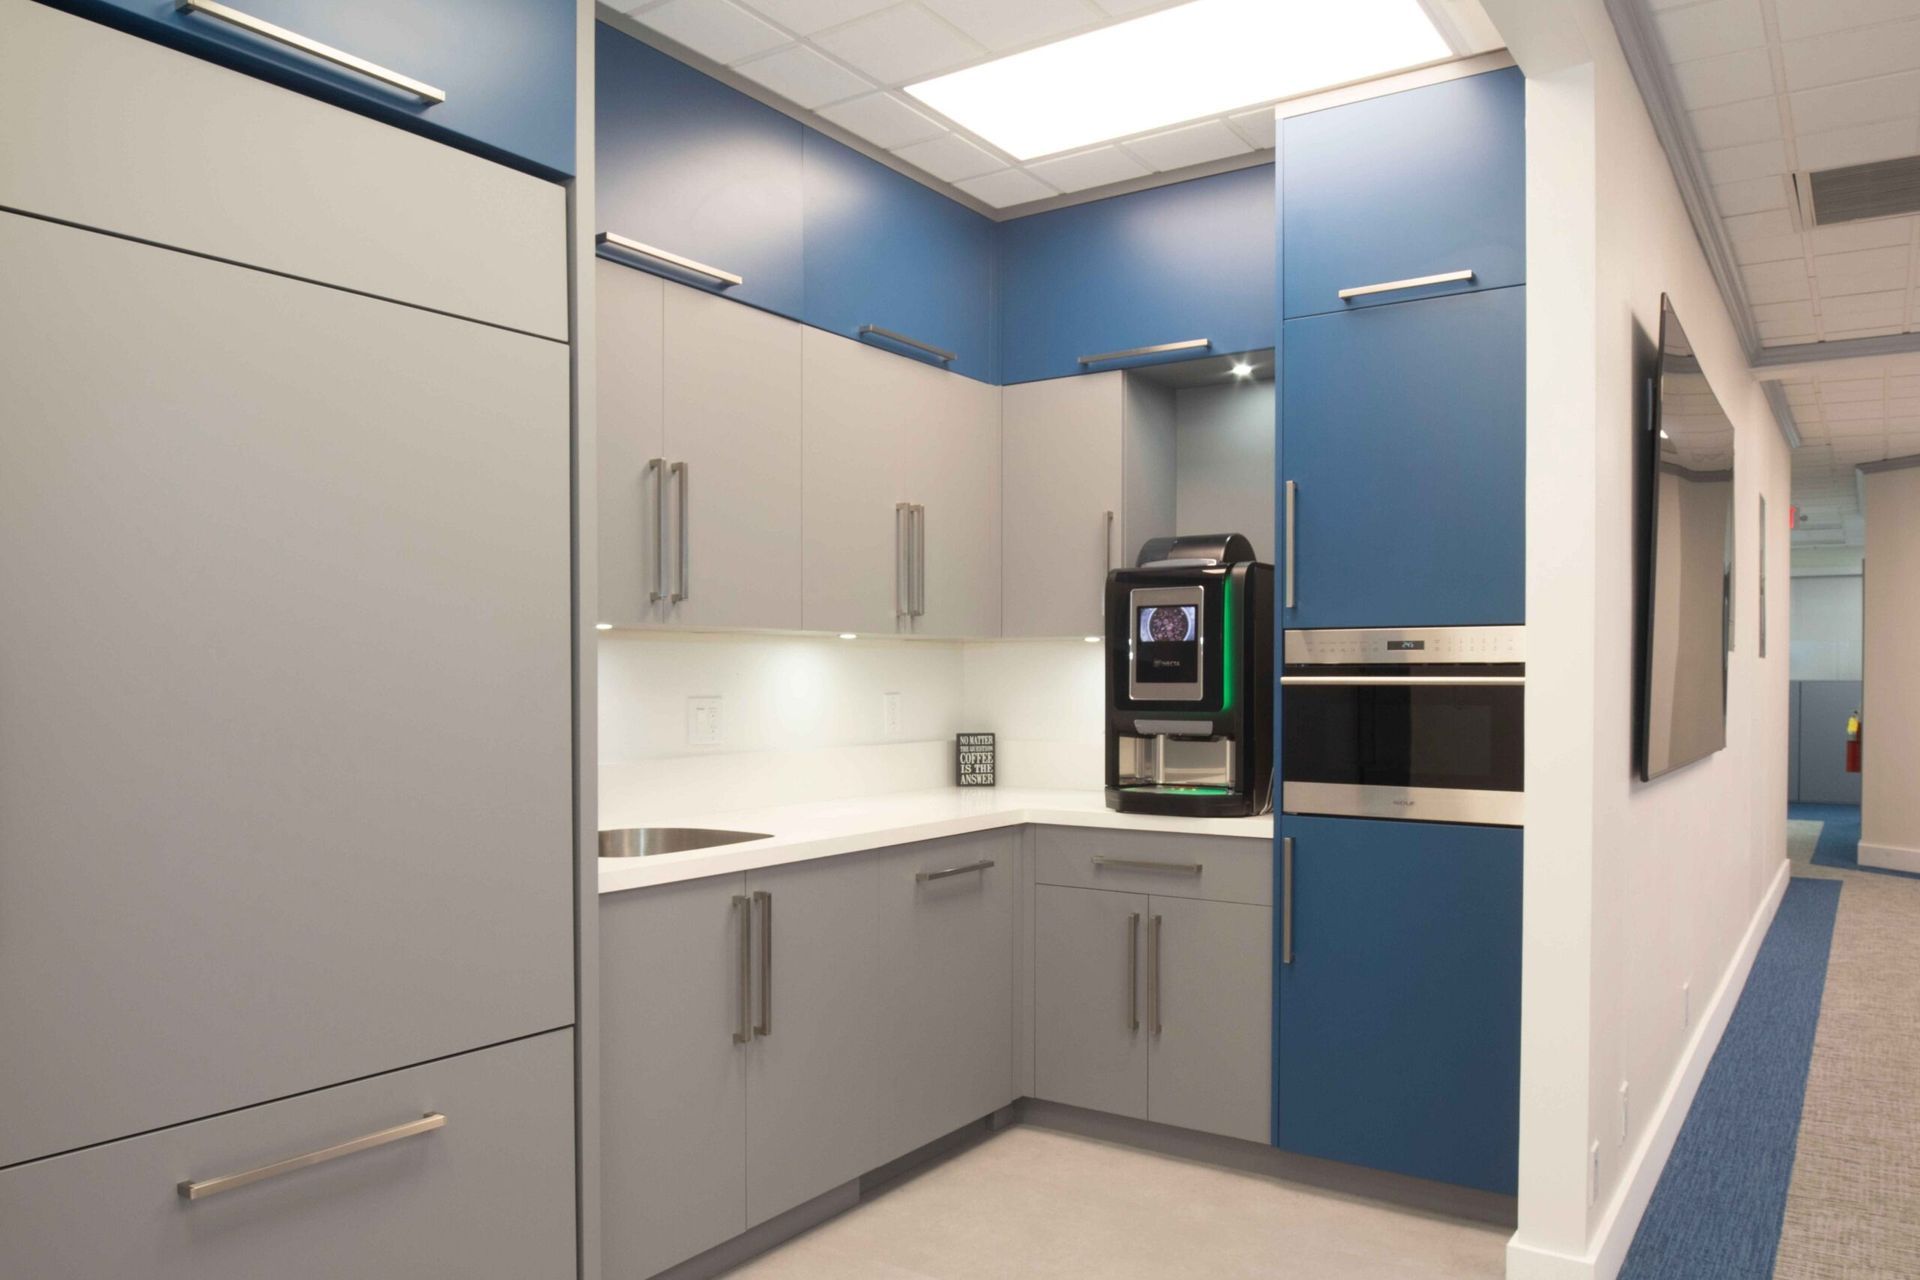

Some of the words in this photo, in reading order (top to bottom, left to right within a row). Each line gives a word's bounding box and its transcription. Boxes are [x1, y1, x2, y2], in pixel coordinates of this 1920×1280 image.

[960, 735, 969, 745] NO
[970, 735, 993, 745] MATTER
[960, 752, 993, 764] COFFEE
[960, 764, 972, 774] IS
[973, 763, 993, 773] THE
[960, 773, 993, 785] ANSWER
